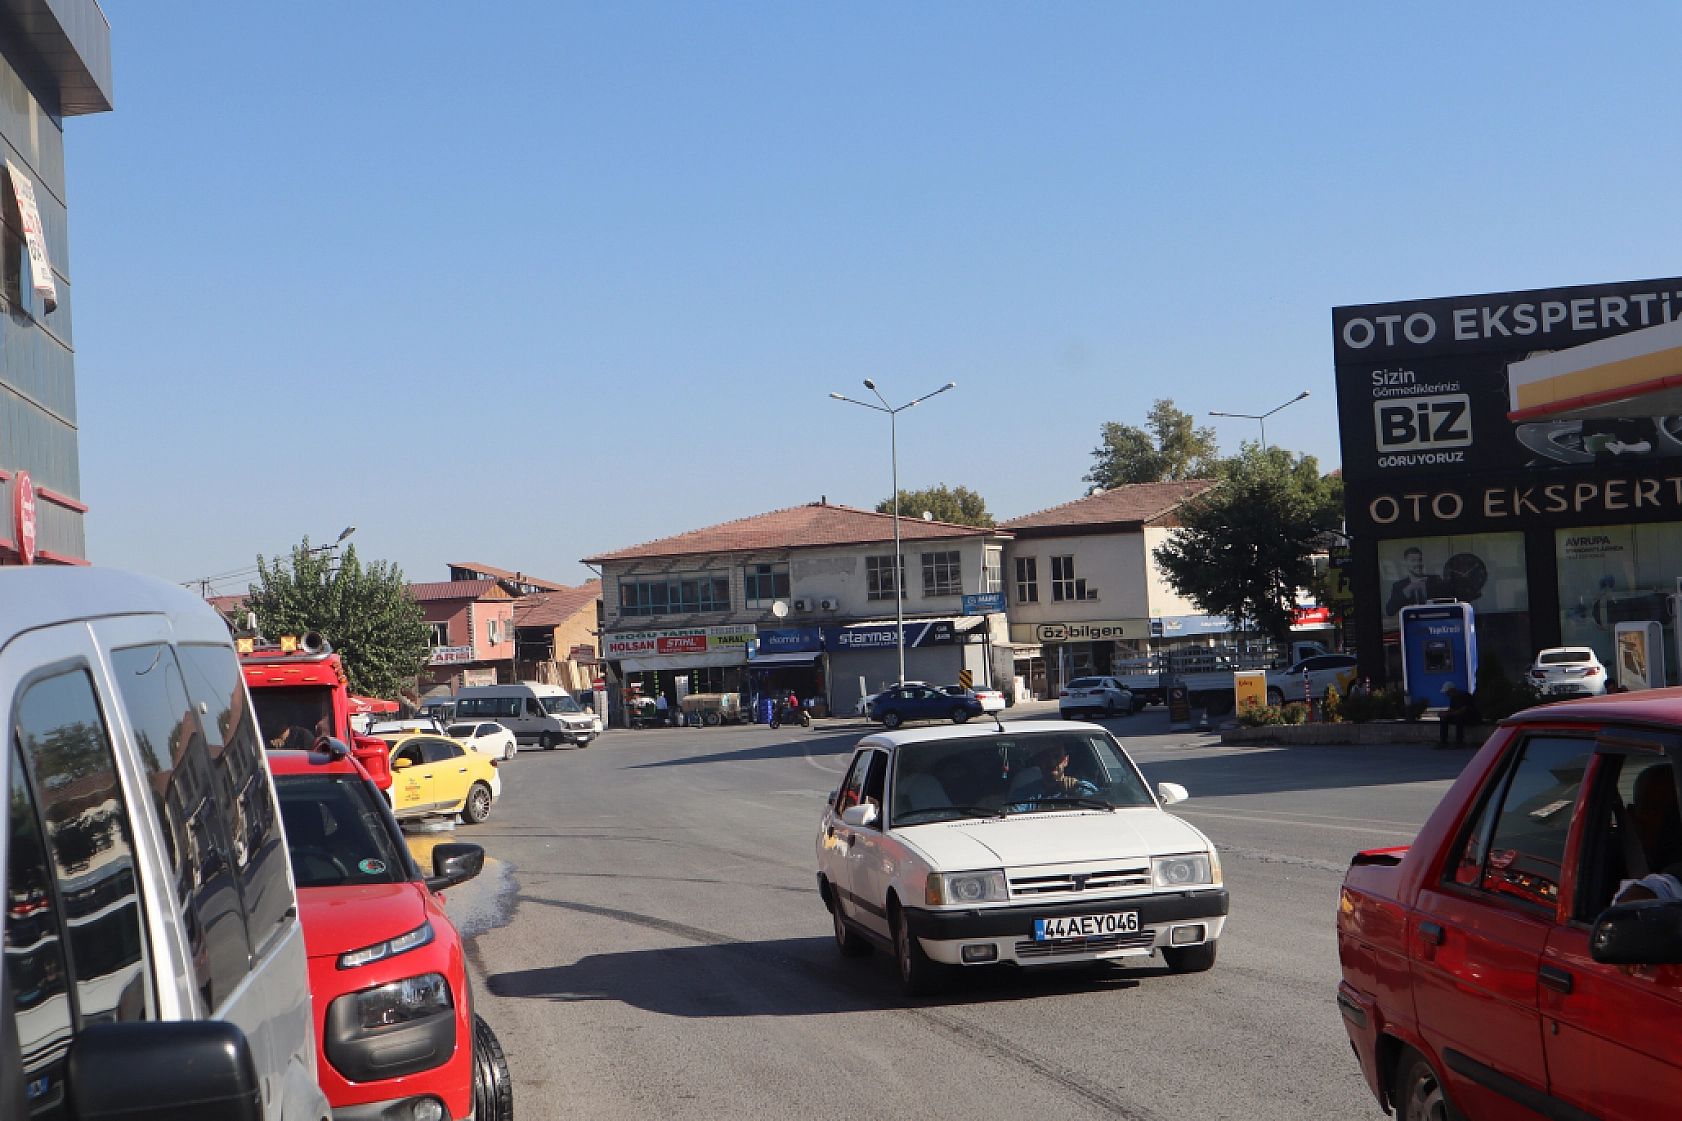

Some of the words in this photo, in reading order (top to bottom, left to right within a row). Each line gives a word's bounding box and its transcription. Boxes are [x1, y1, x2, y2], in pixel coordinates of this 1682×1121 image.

[1343, 312, 1437, 349] OTO
[1372, 367, 1416, 385] Sizin
[1372, 380, 1460, 397] Görmediklerinizi
[1369, 492, 1464, 523] OTO
[1566, 535, 1611, 547] AVRUPA
[609, 640, 655, 653] HOLSAN
[717, 635, 745, 644] TARAL
[1045, 913, 1137, 936] 44AEY046
